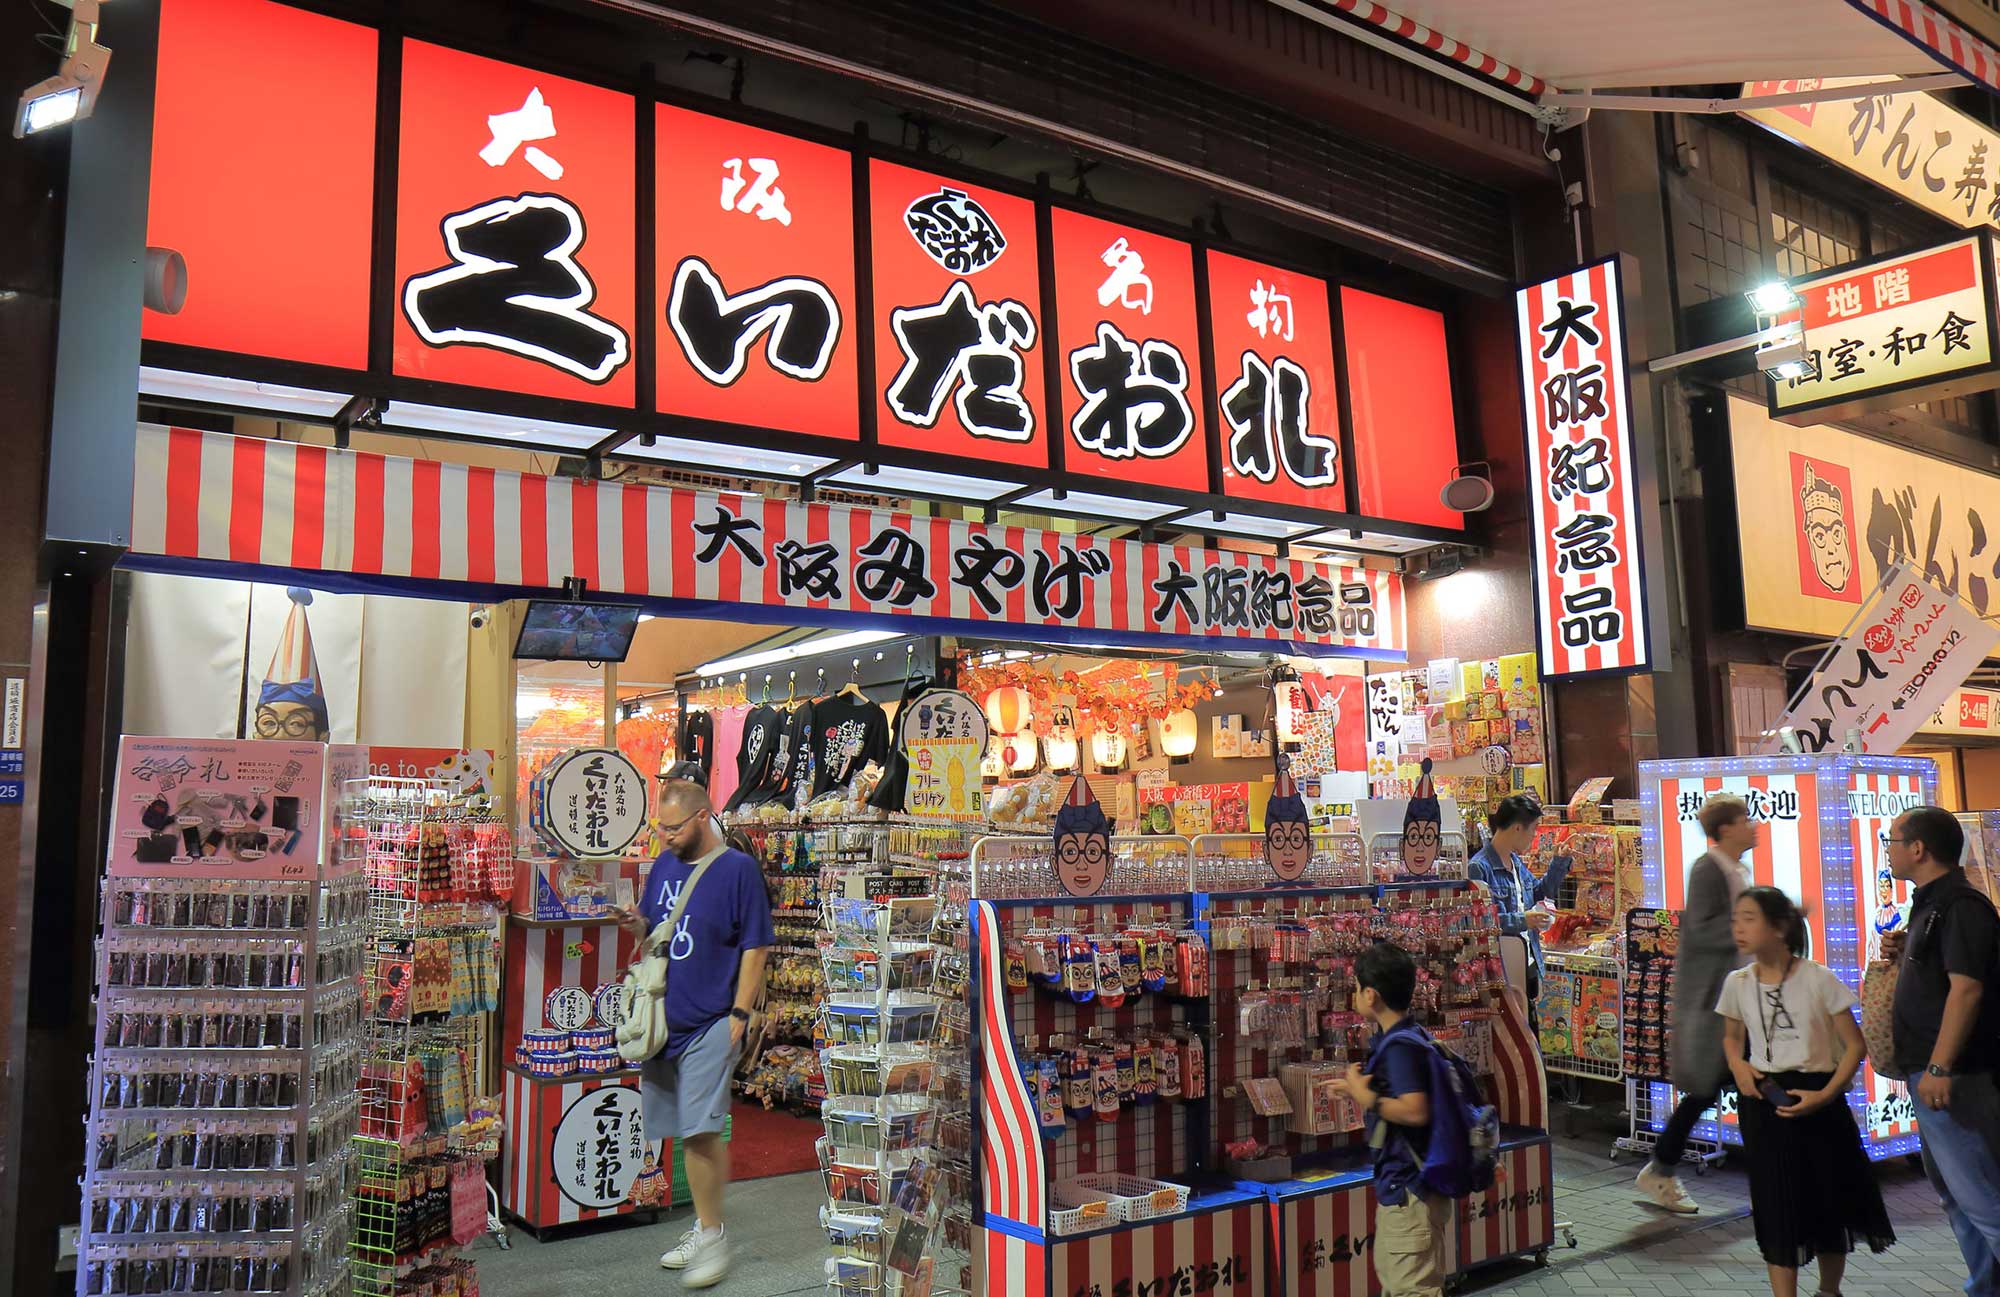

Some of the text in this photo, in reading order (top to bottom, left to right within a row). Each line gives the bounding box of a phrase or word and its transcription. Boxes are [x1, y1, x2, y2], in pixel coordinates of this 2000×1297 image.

[1849, 93, 2000, 222] がんこ寿
[1826, 268, 1910, 318] 地階
[1541, 299, 1621, 648] 大阪紀念品
[695, 504, 1110, 620] 大阪みやげ
[1153, 560, 1377, 639] 大阪紀念品
[583, 756, 609, 848] くいだおれ
[913, 791, 945, 808] ビリケン
[1144, 784, 1241, 802] 大阪 心斎橋シリーズ
[1680, 789, 1797, 821] 热欢迎
[1848, 792, 1918, 818] WELCOME
[593, 1092, 623, 1200] くいだおれ
[629, 1108, 642, 1160] 大阪名物
